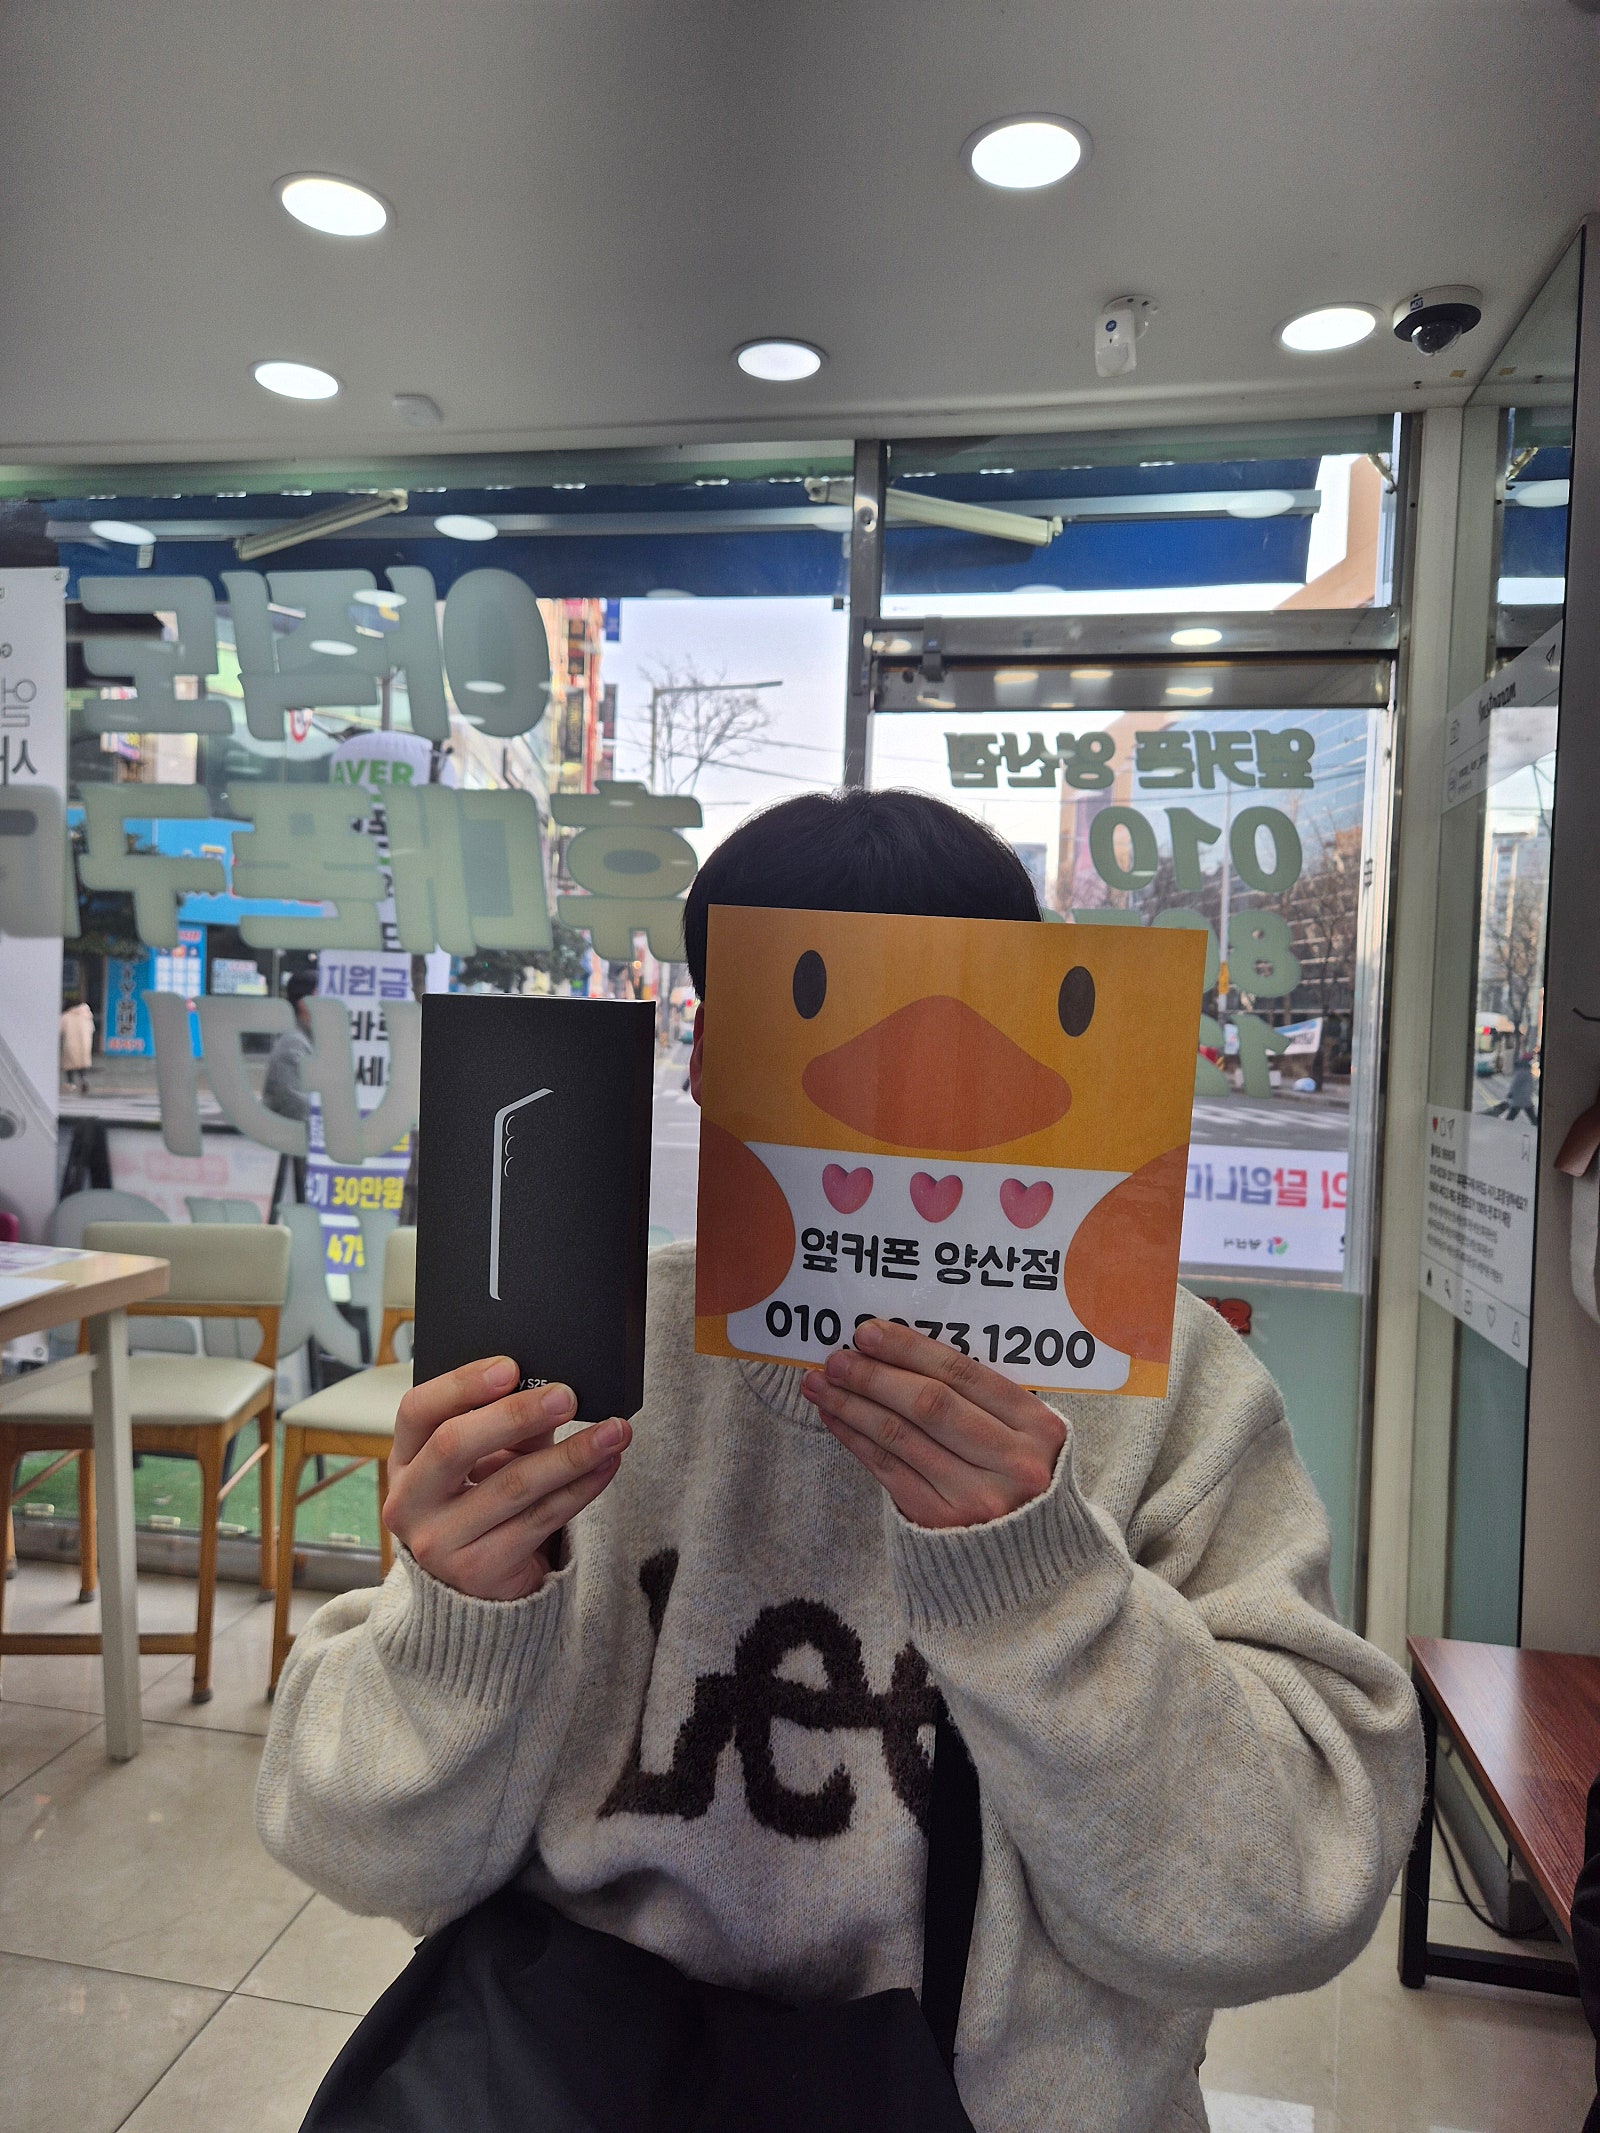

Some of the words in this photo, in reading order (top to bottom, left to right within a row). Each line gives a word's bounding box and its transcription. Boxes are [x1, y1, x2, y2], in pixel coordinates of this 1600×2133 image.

[325, 963, 409, 999] 지원금
[332, 1176, 404, 1210] 30만원
[799, 1226, 921, 1282] 옆커폰
[933, 1241, 1062, 1292] 양산점
